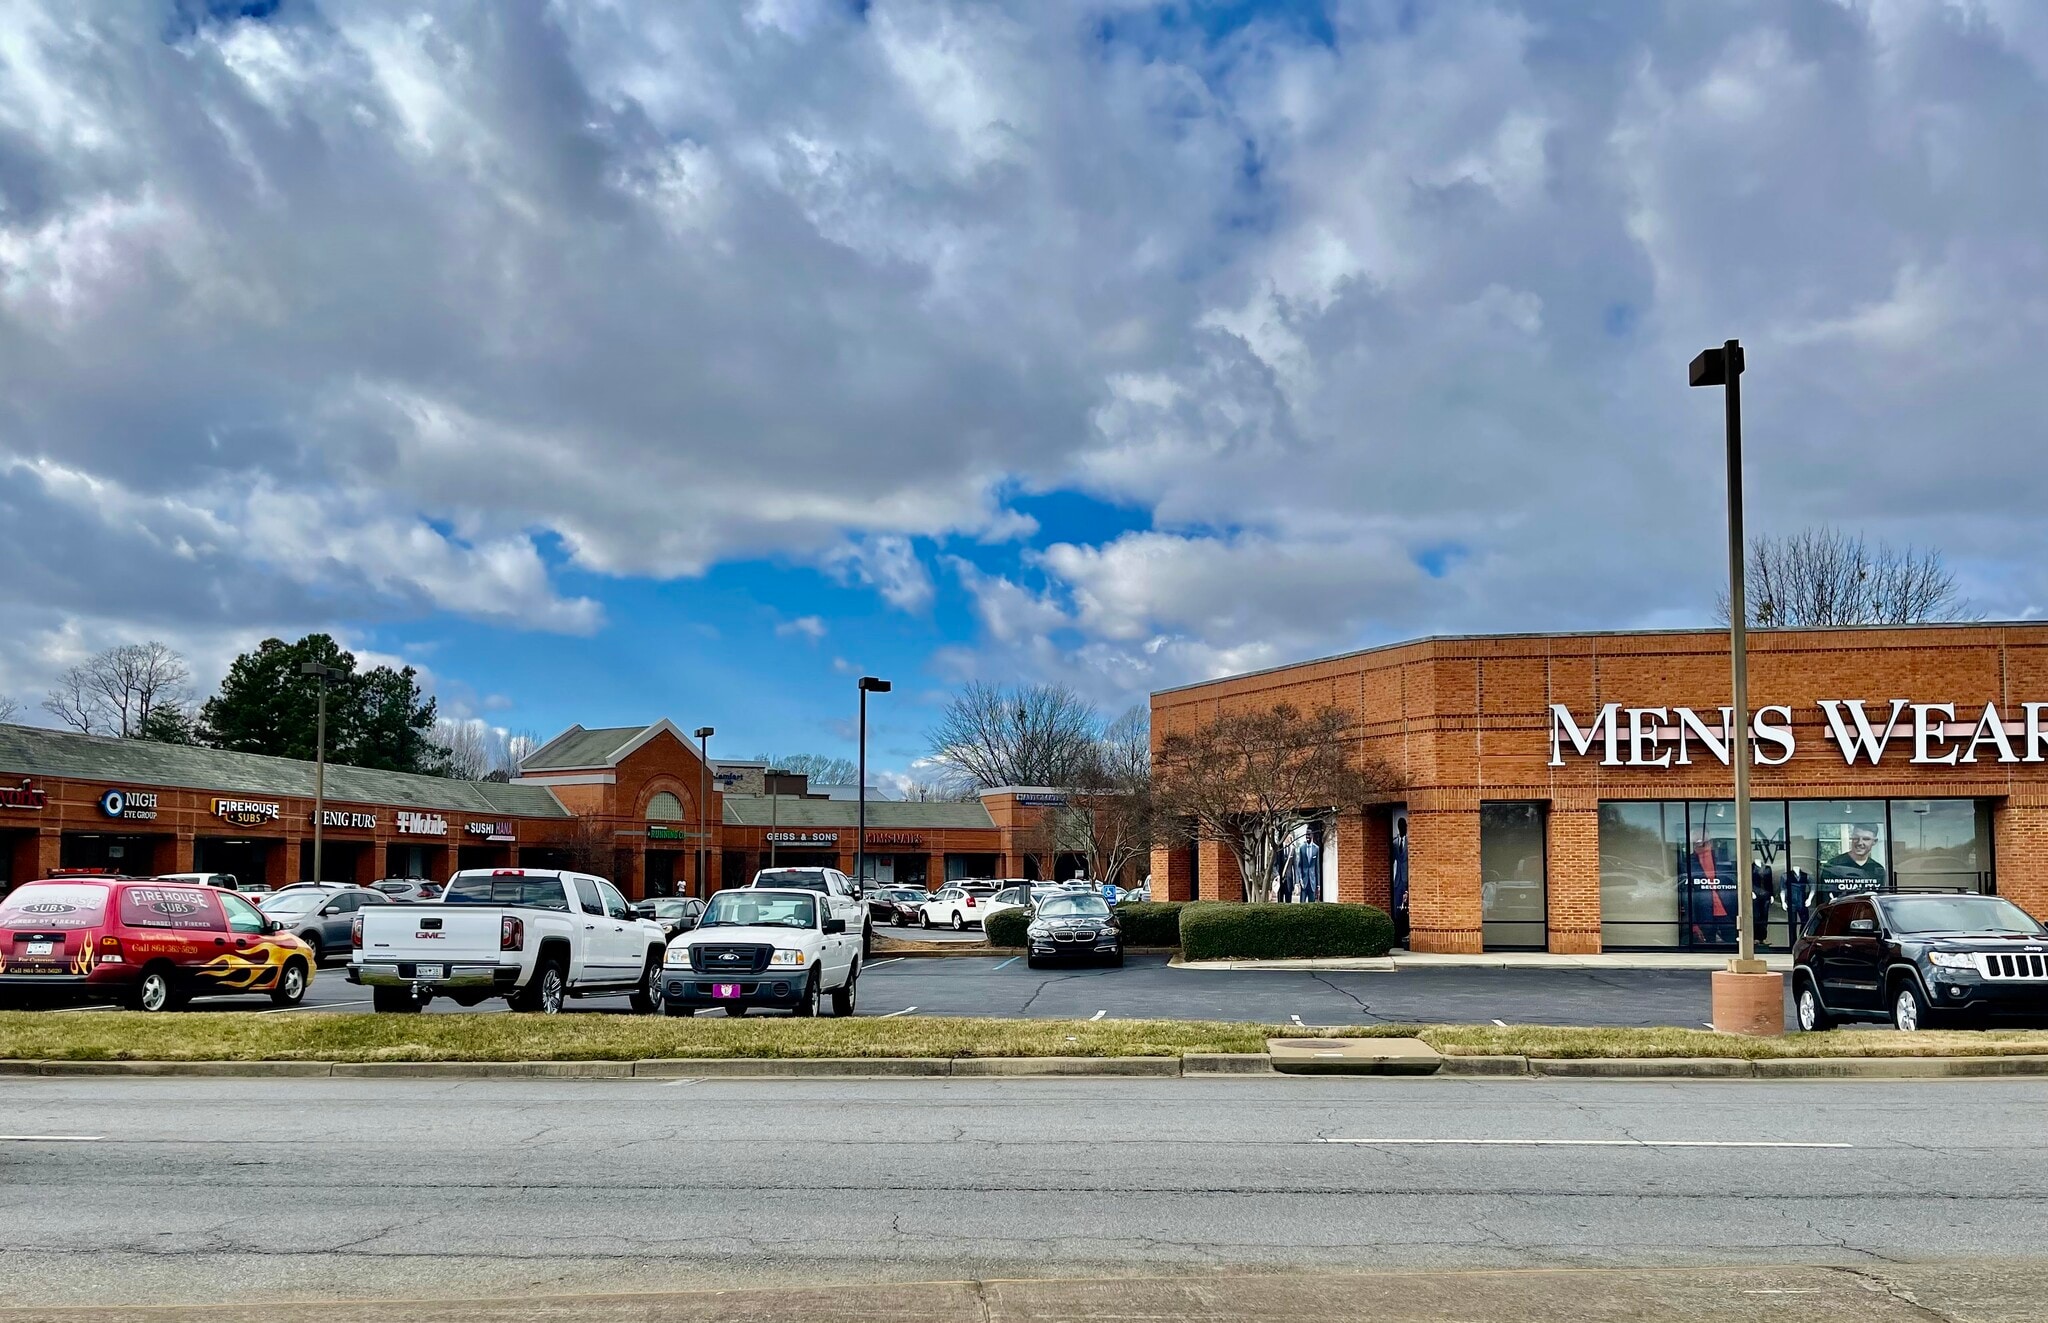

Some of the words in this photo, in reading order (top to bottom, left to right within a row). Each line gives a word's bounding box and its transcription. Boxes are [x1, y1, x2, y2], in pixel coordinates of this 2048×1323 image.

[1548, 703, 1796, 768] MENS
[125, 792, 158, 807] NIGH
[124, 810, 136, 818] EYE
[136, 811, 158, 819] GROUP
[218, 800, 280, 820] FIREHOUSE
[237, 812, 261, 823] SUBS
[351, 813, 377, 828] FURS
[396, 811, 448, 836] T-Mobile
[470, 822, 494, 834] SUSHI
[495, 822, 513, 835] HANA
[766, 832, 796, 841] GEISS
[800, 833, 807, 841] &
[812, 832, 838, 841] SONS
[130, 889, 210, 910] FIREHOUSE
[31, 904, 66, 912] SUBS
[160, 902, 190, 913] SUBS
[415, 931, 446, 940] GMC
[131, 943, 150, 953] Call
